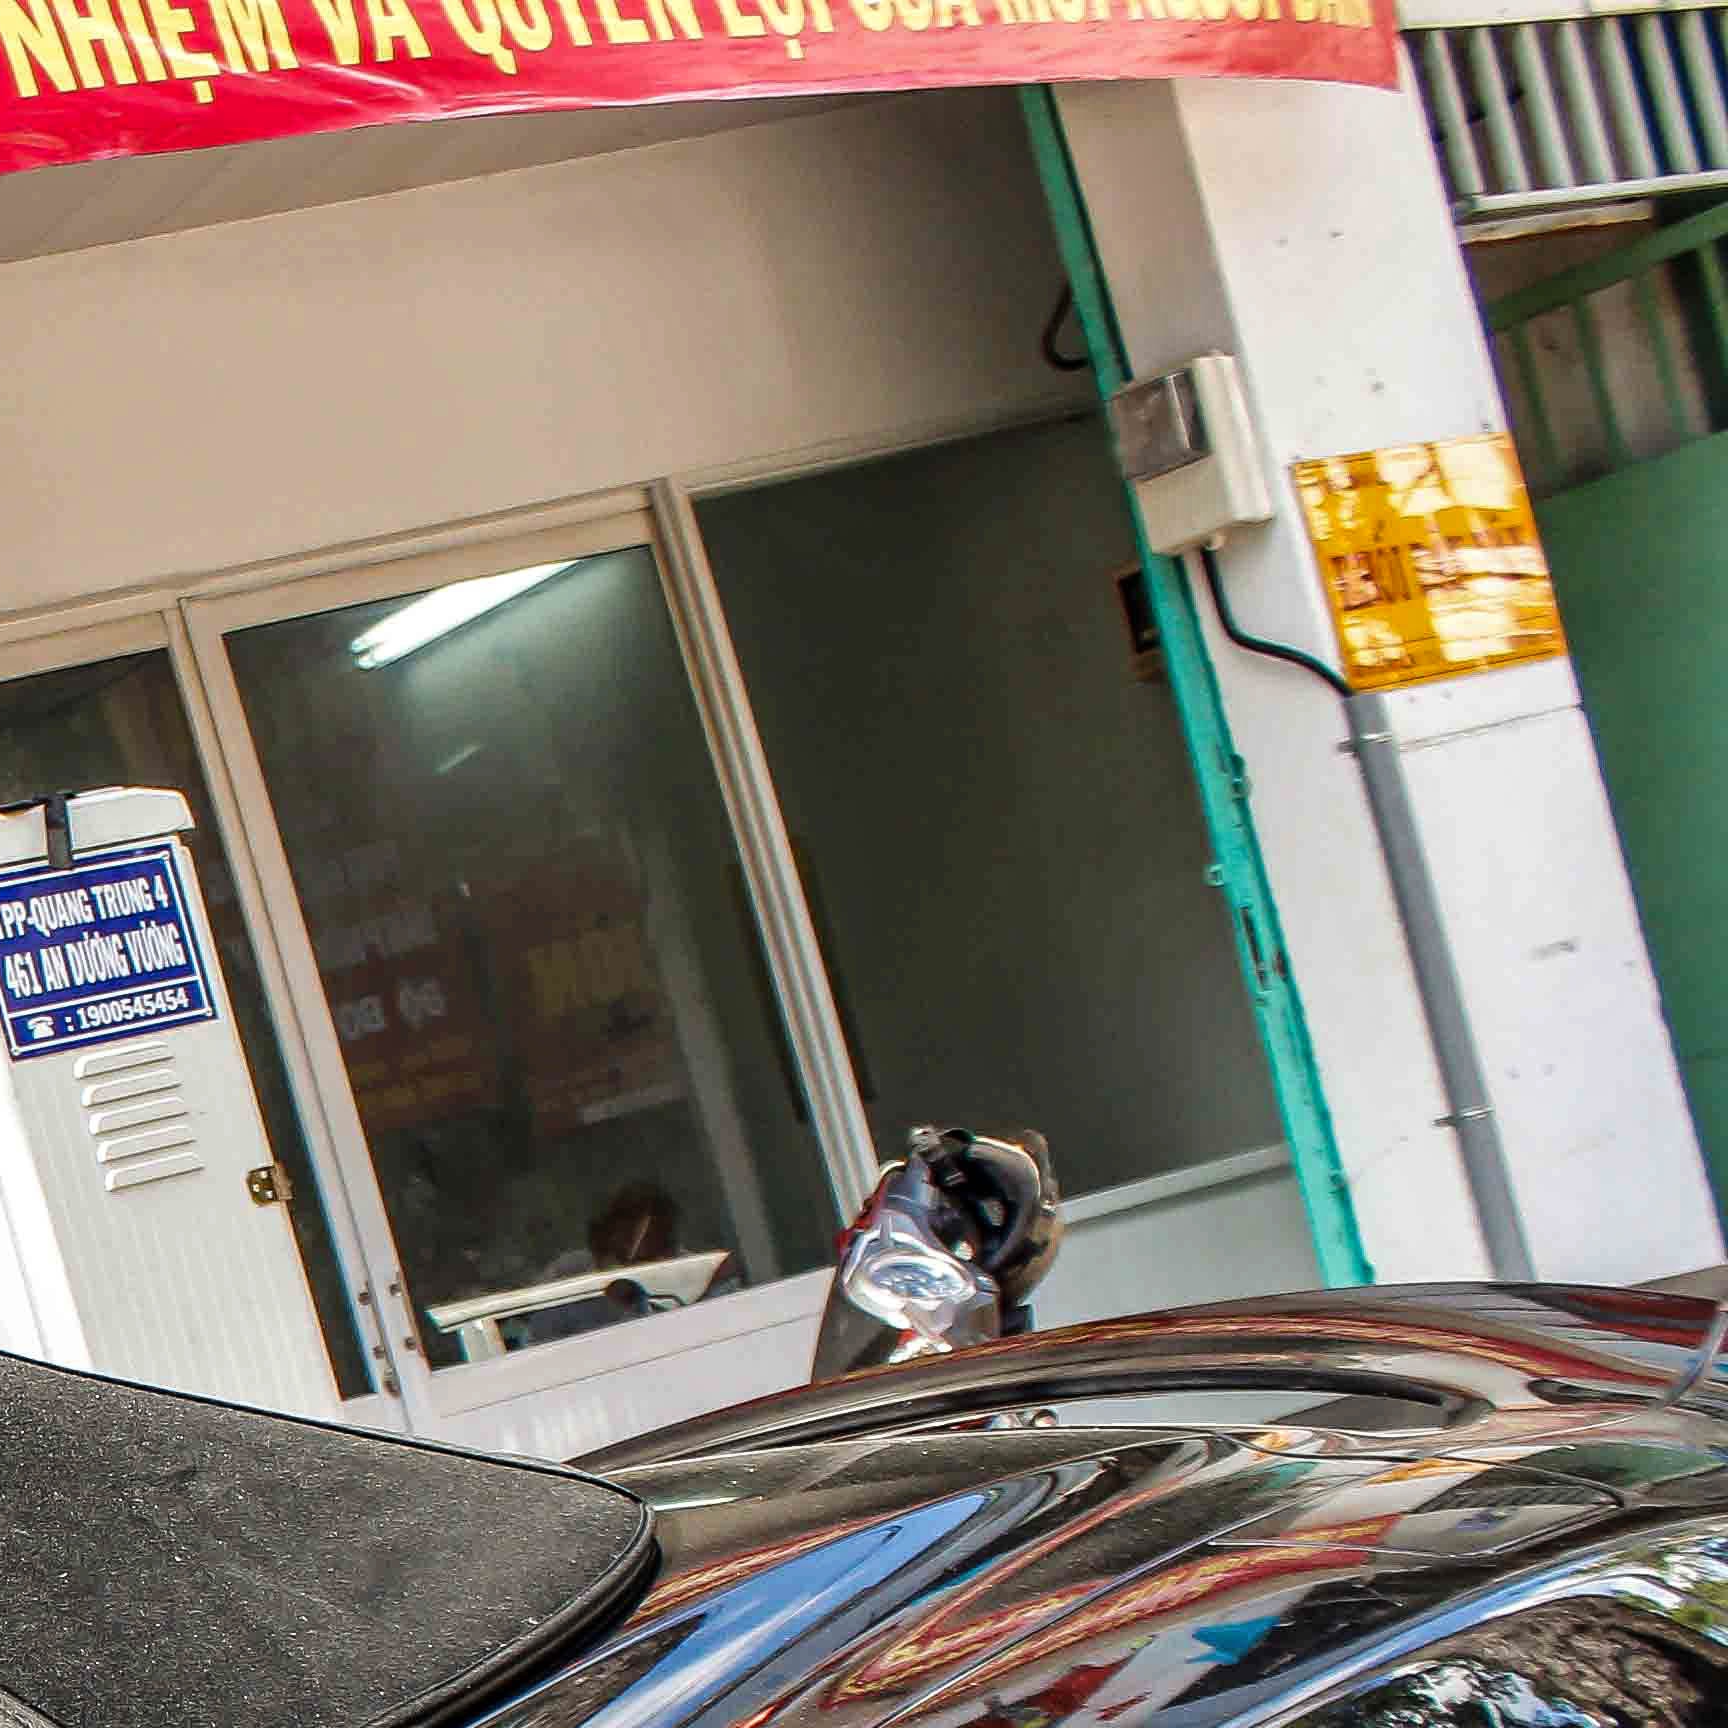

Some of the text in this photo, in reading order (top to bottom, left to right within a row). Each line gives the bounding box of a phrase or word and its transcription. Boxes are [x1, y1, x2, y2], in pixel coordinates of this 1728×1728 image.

[91, 877, 151, 920] TRUNG
[152, 874, 169, 908] 4
[4, 951, 43, 999] 461
[40, 945, 70, 992] AN
